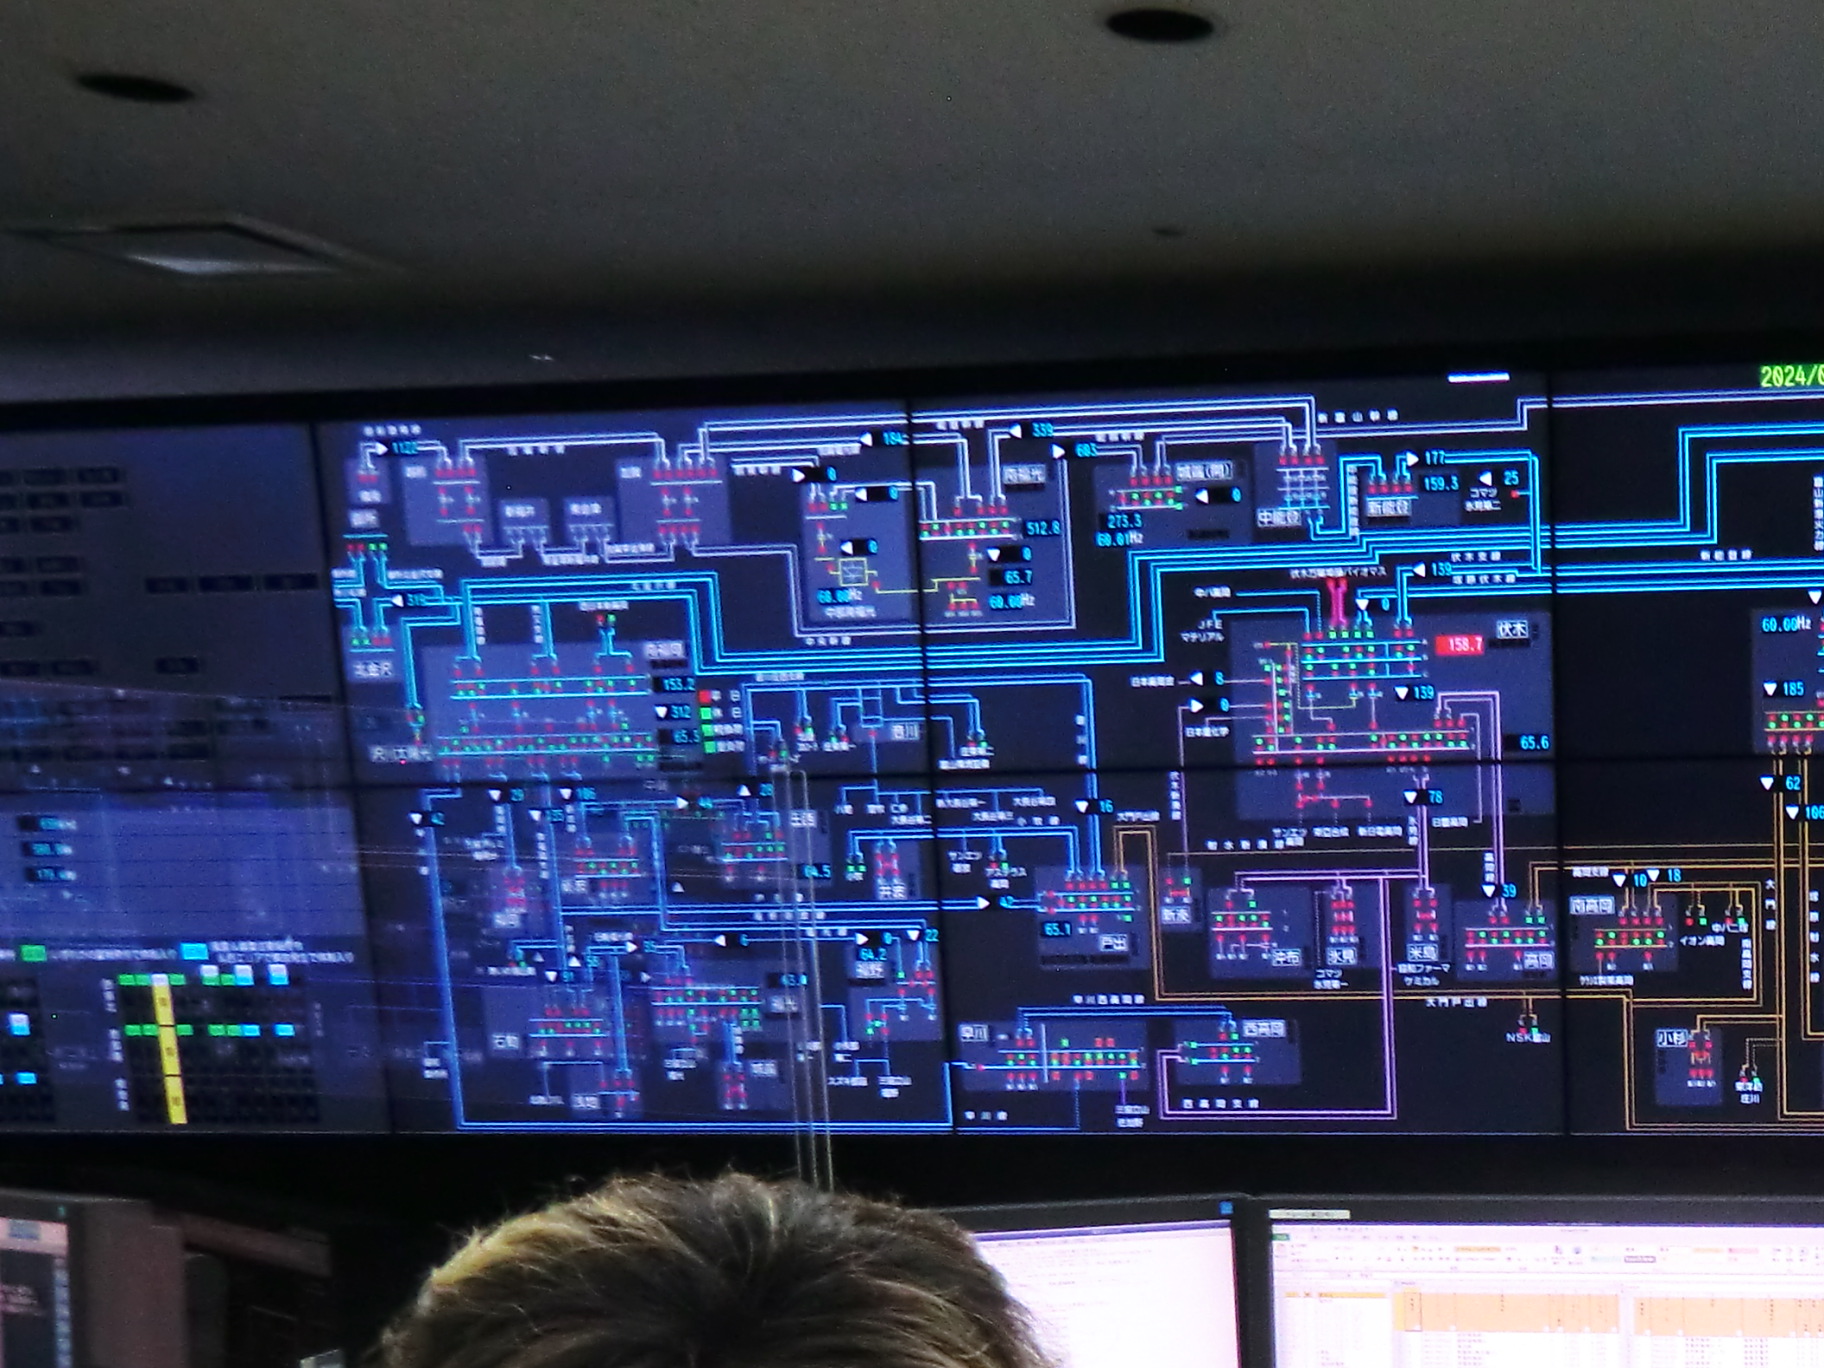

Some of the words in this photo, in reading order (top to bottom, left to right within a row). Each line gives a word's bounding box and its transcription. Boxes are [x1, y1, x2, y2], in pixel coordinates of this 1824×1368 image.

[1424, 476, 1459, 491] 159.3
[1503, 470, 1519, 485] 25
[1026, 520, 1060, 536] 512.8
[1005, 570, 1032, 584] 65.7
[1381, 599, 1390, 612] 0
[1199, 620, 1223, 629] JFE
[1498, 621, 1528, 638] 伏木
[1449, 638, 1483, 653] 158.7
[1414, 686, 1435, 700] 159
[1783, 682, 1804, 695] 185
[1521, 735, 1549, 750] 65.6
[1786, 776, 1800, 790] 62
[1429, 790, 1443, 803] 78
[1634, 874, 1647, 887] 10
[1668, 869, 1681, 882] 18
[1502, 885, 1517, 898] 39
[1658, 1031, 1687, 1046] 小杉
